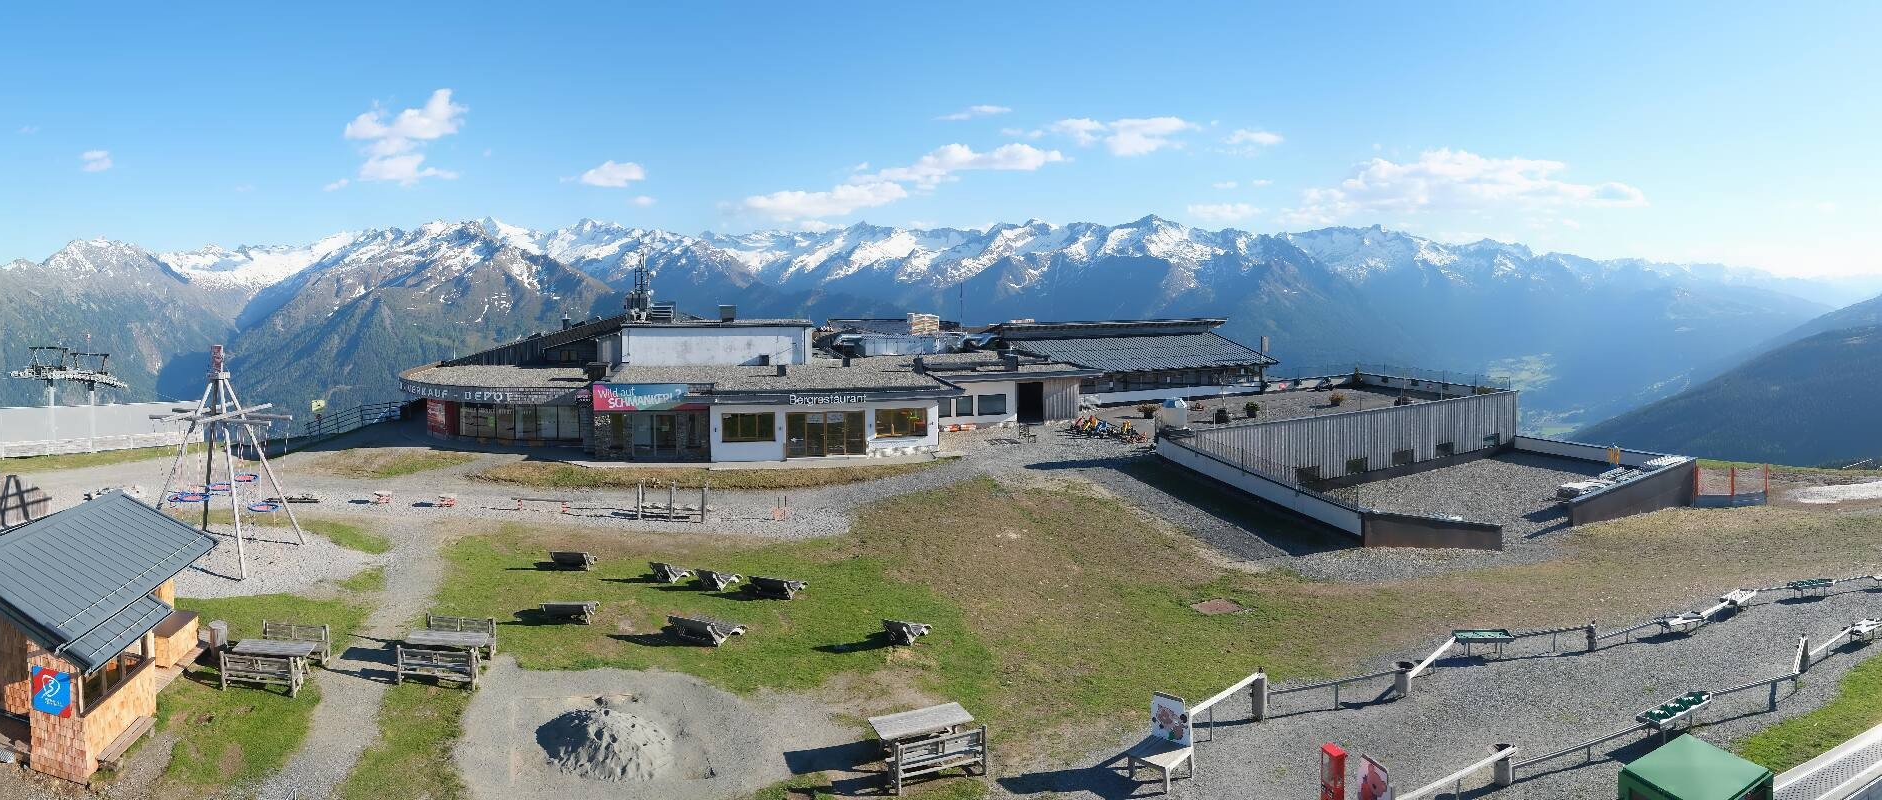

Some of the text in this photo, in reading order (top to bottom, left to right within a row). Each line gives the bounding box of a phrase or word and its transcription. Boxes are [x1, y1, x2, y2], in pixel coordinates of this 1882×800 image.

[407, 384, 449, 398] VERKAUF
[464, 390, 512, 402] DEPOT
[597, 387, 618, 399] Wild
[789, 393, 867, 406] Bergrestaurant
